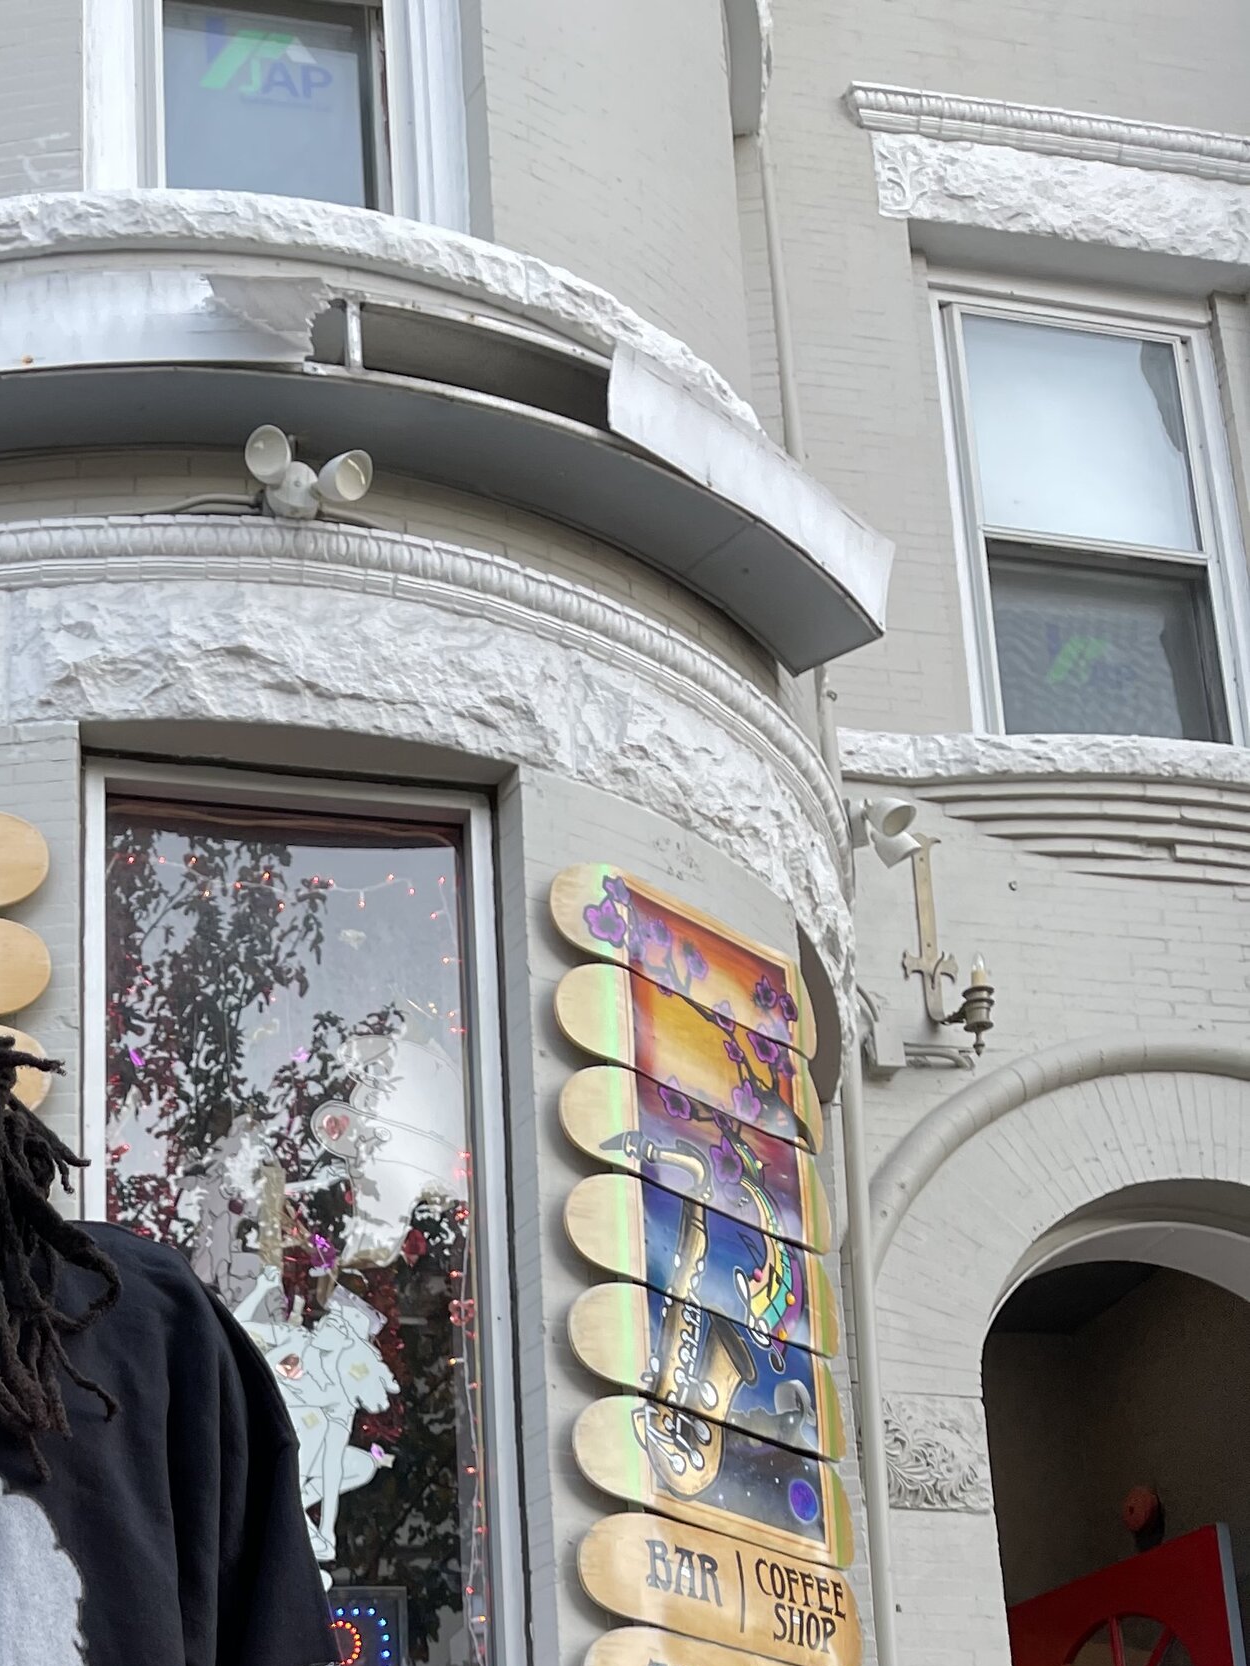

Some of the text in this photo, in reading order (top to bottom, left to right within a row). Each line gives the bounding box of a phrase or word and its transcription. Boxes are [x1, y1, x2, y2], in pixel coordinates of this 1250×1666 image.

[644, 1539, 847, 1620] BAR COFFEE
[773, 1603, 837, 1654] SHOP
